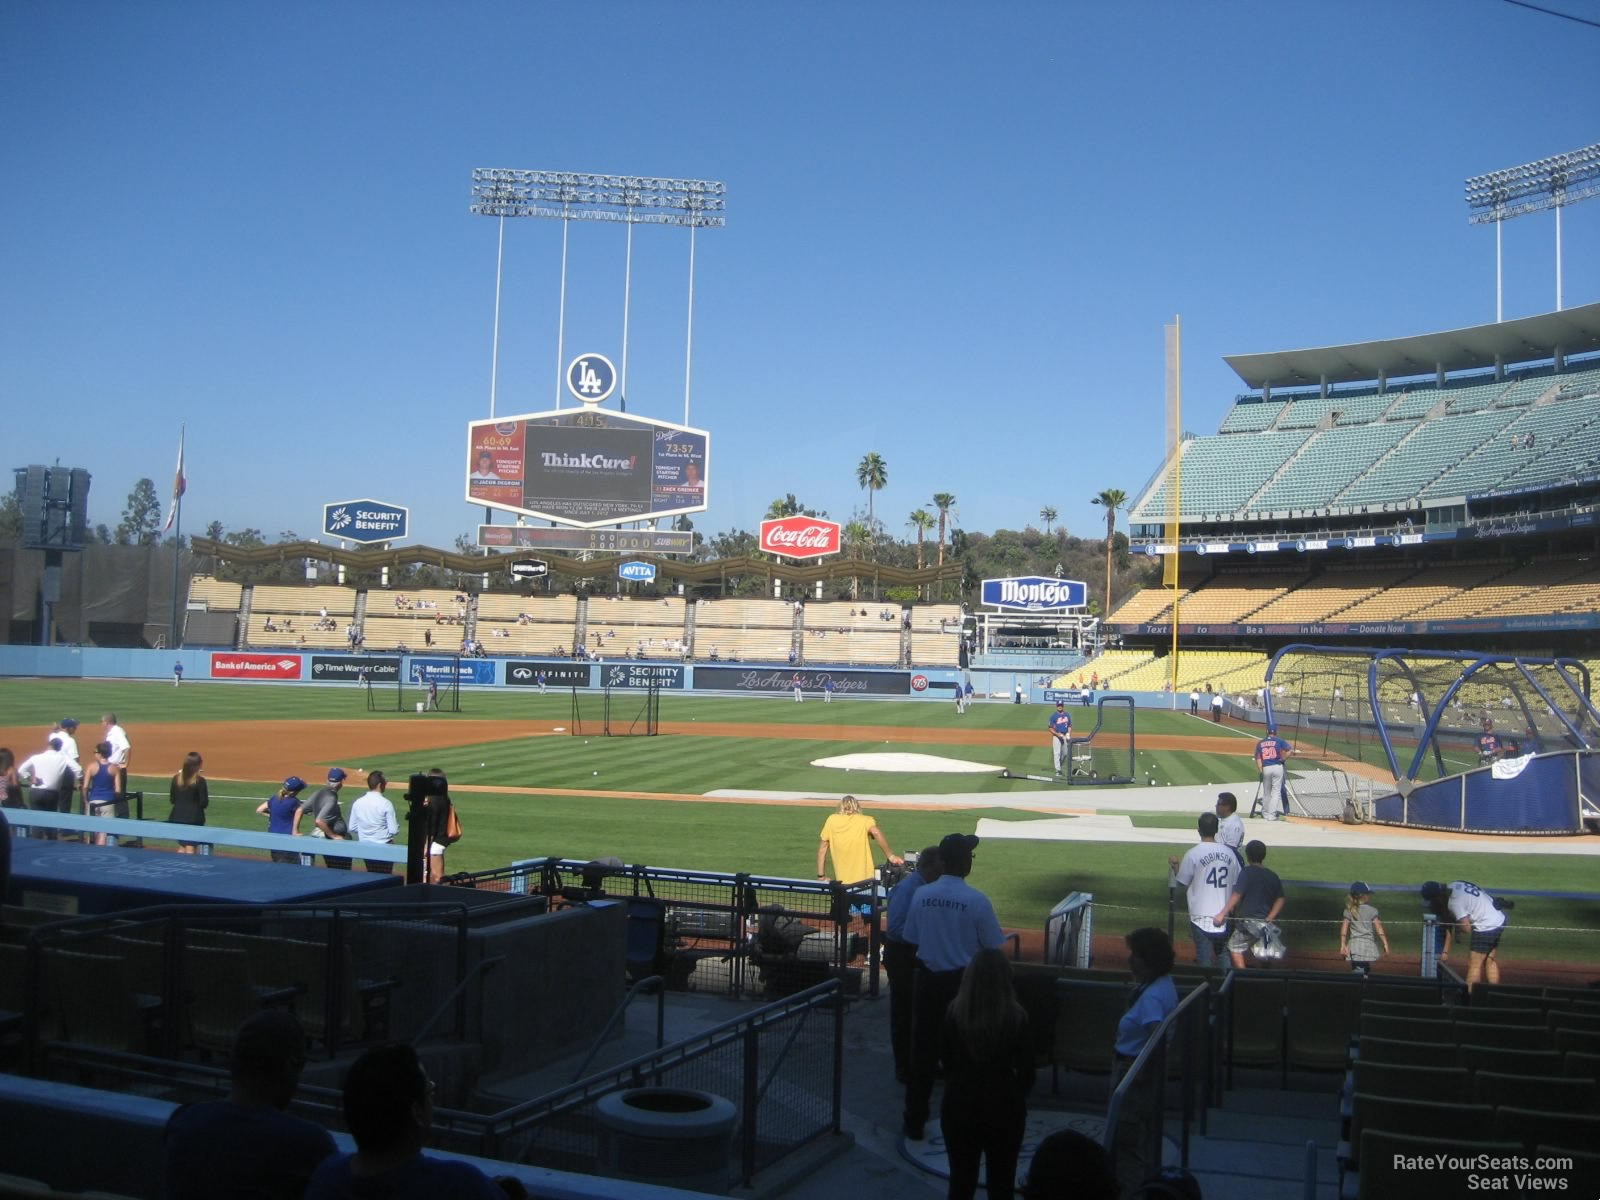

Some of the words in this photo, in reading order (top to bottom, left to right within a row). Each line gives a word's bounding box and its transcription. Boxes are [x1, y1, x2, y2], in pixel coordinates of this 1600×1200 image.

[578, 361, 602, 393] LA
[483, 437, 512, 446] 60-69
[666, 444, 693, 453] 73-57
[541, 452, 637, 470] ThinkCure!
[356, 510, 402, 520] SECURITY
[600, 534, 606, 542] 0
[610, 534, 614, 542] 0
[655, 538, 690, 546] SUBWAY
[766, 526, 833, 548] Coca-Cola
[610, 542, 615, 550] 0
[620, 538, 626, 548] 0
[632, 538, 638, 548] 0
[643, 538, 650, 548] 0
[623, 566, 652, 576] AVITA
[1000, 580, 1070, 605] Montejo
[1198, 626, 1208, 634] to
[1246, 626, 1256, 634] Be
[1359, 625, 1386, 633] Donate
[1387, 624, 1406, 632] Now!
[216, 661, 236, 669] Bank
[236, 662, 244, 670] of
[244, 662, 276, 670] America
[325, 664, 344, 672] Time
[374, 665, 397, 673] Cable
[736, 670, 760, 688] Los
[913, 679, 926, 688] 76
[1262, 746, 1277, 760] 20
[1200, 852, 1232, 867] ROBINSON
[1206, 867, 1228, 888] 42
[922, 898, 968, 912] SECURITY
